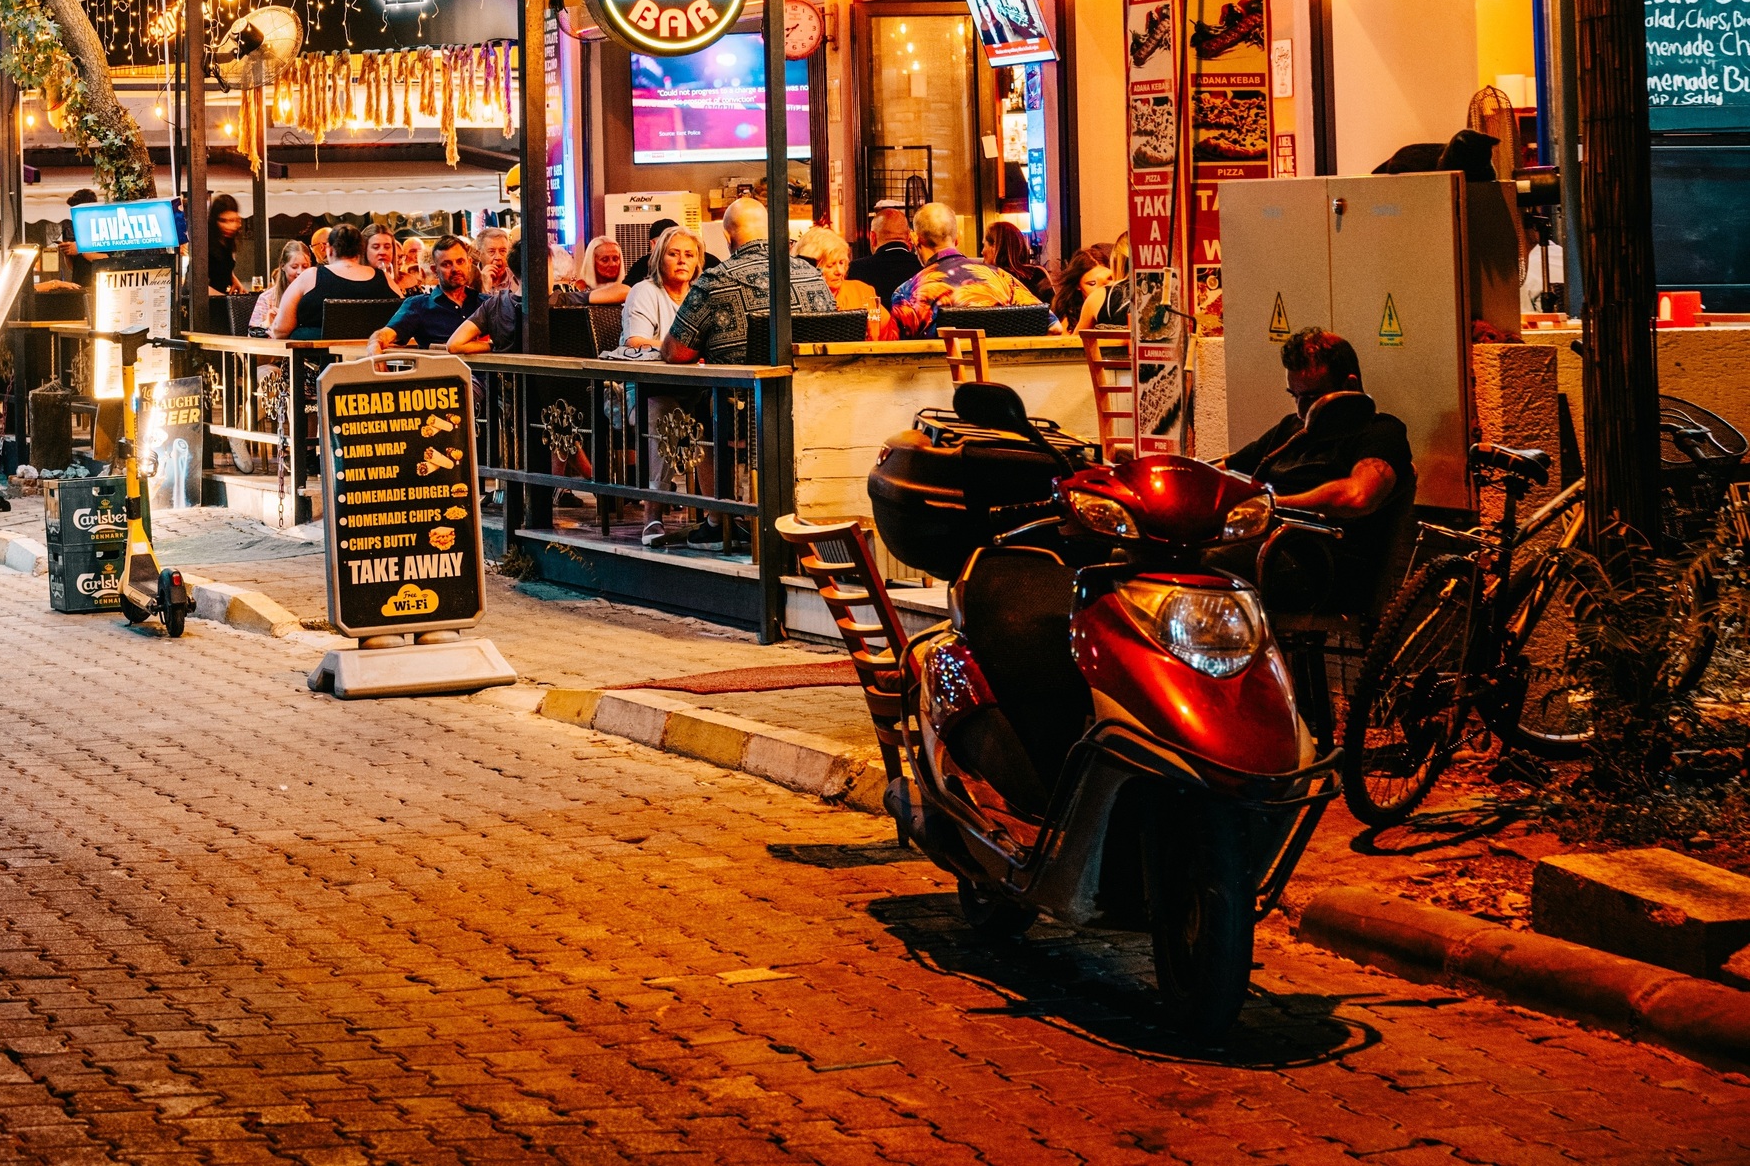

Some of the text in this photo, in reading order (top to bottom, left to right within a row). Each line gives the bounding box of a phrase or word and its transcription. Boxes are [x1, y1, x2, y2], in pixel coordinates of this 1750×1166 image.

[1197, 75, 1261, 84] ADANA KEBAB
[692, 88, 719, 97] progress
[1145, 175, 1161, 183] PIZZA
[1217, 168, 1245, 177] PIZZA
[90, 207, 163, 242] LAVAZZA
[1150, 220, 1161, 241] A
[91, 237, 163, 248] ITALY'S FAVOURITE COFFEE
[106, 271, 149, 289] TINTIN
[142, 394, 201, 412] DRAUGHT
[335, 387, 460, 417] KEBAB HOUSE
[155, 408, 201, 427] BEER
[341, 418, 422, 436] CHICKEN WRAP
[343, 442, 407, 459] LAMB WRAP
[1154, 442, 1167, 450] PIDE
[345, 465, 400, 482] MIX WRAP
[346, 485, 450, 505] HOMEMADE BURGER
[347, 508, 442, 528] HOMEMADE CHIPS
[91, 532, 124, 540] DENMARK
[349, 533, 417, 551] CHIPS BUTTY
[347, 551, 464, 585] TAKE AWAY
[402, 590, 418, 599] Free
[393, 598, 428, 611] Wi-Fi
